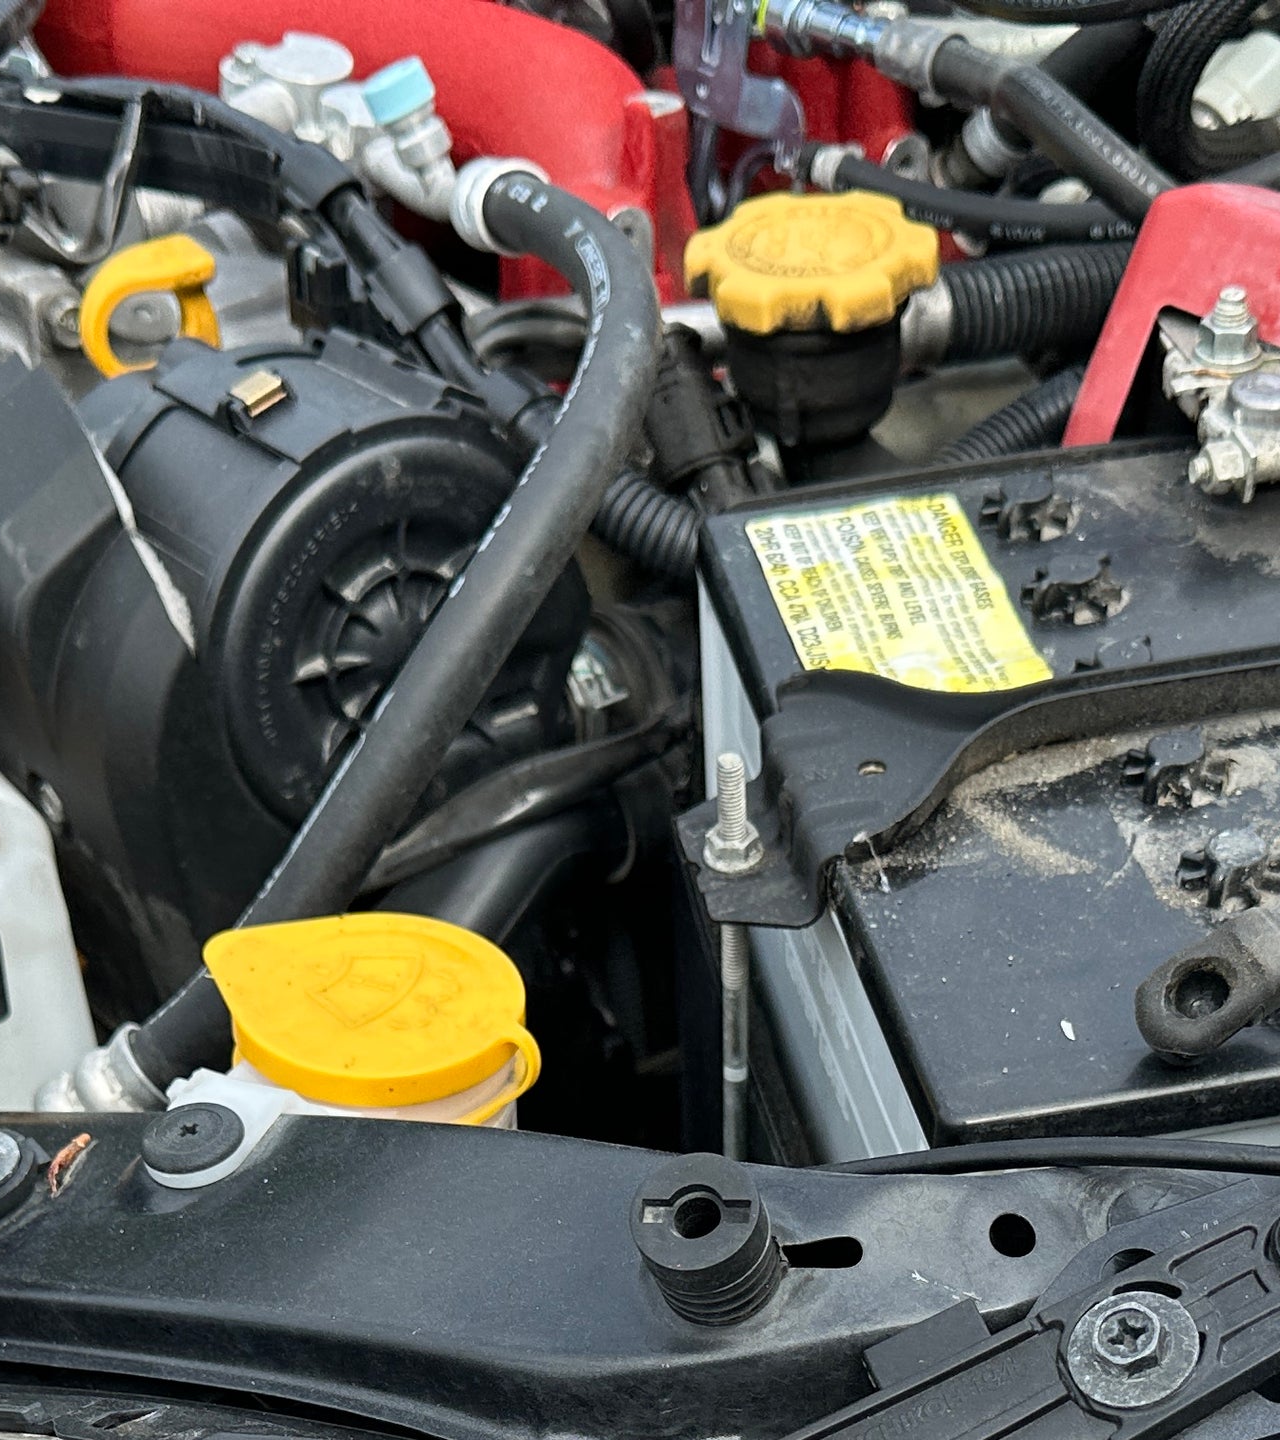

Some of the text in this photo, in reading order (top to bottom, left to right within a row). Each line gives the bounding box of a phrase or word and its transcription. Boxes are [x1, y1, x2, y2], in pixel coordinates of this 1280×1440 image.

[830, 515, 868, 555] POISON
[923, 501, 967, 548] DANGER
[963, 580, 999, 612] GASES
[774, 577, 804, 602] CCA
[893, 579, 918, 600] AND
[900, 598, 931, 627] LEVEL
